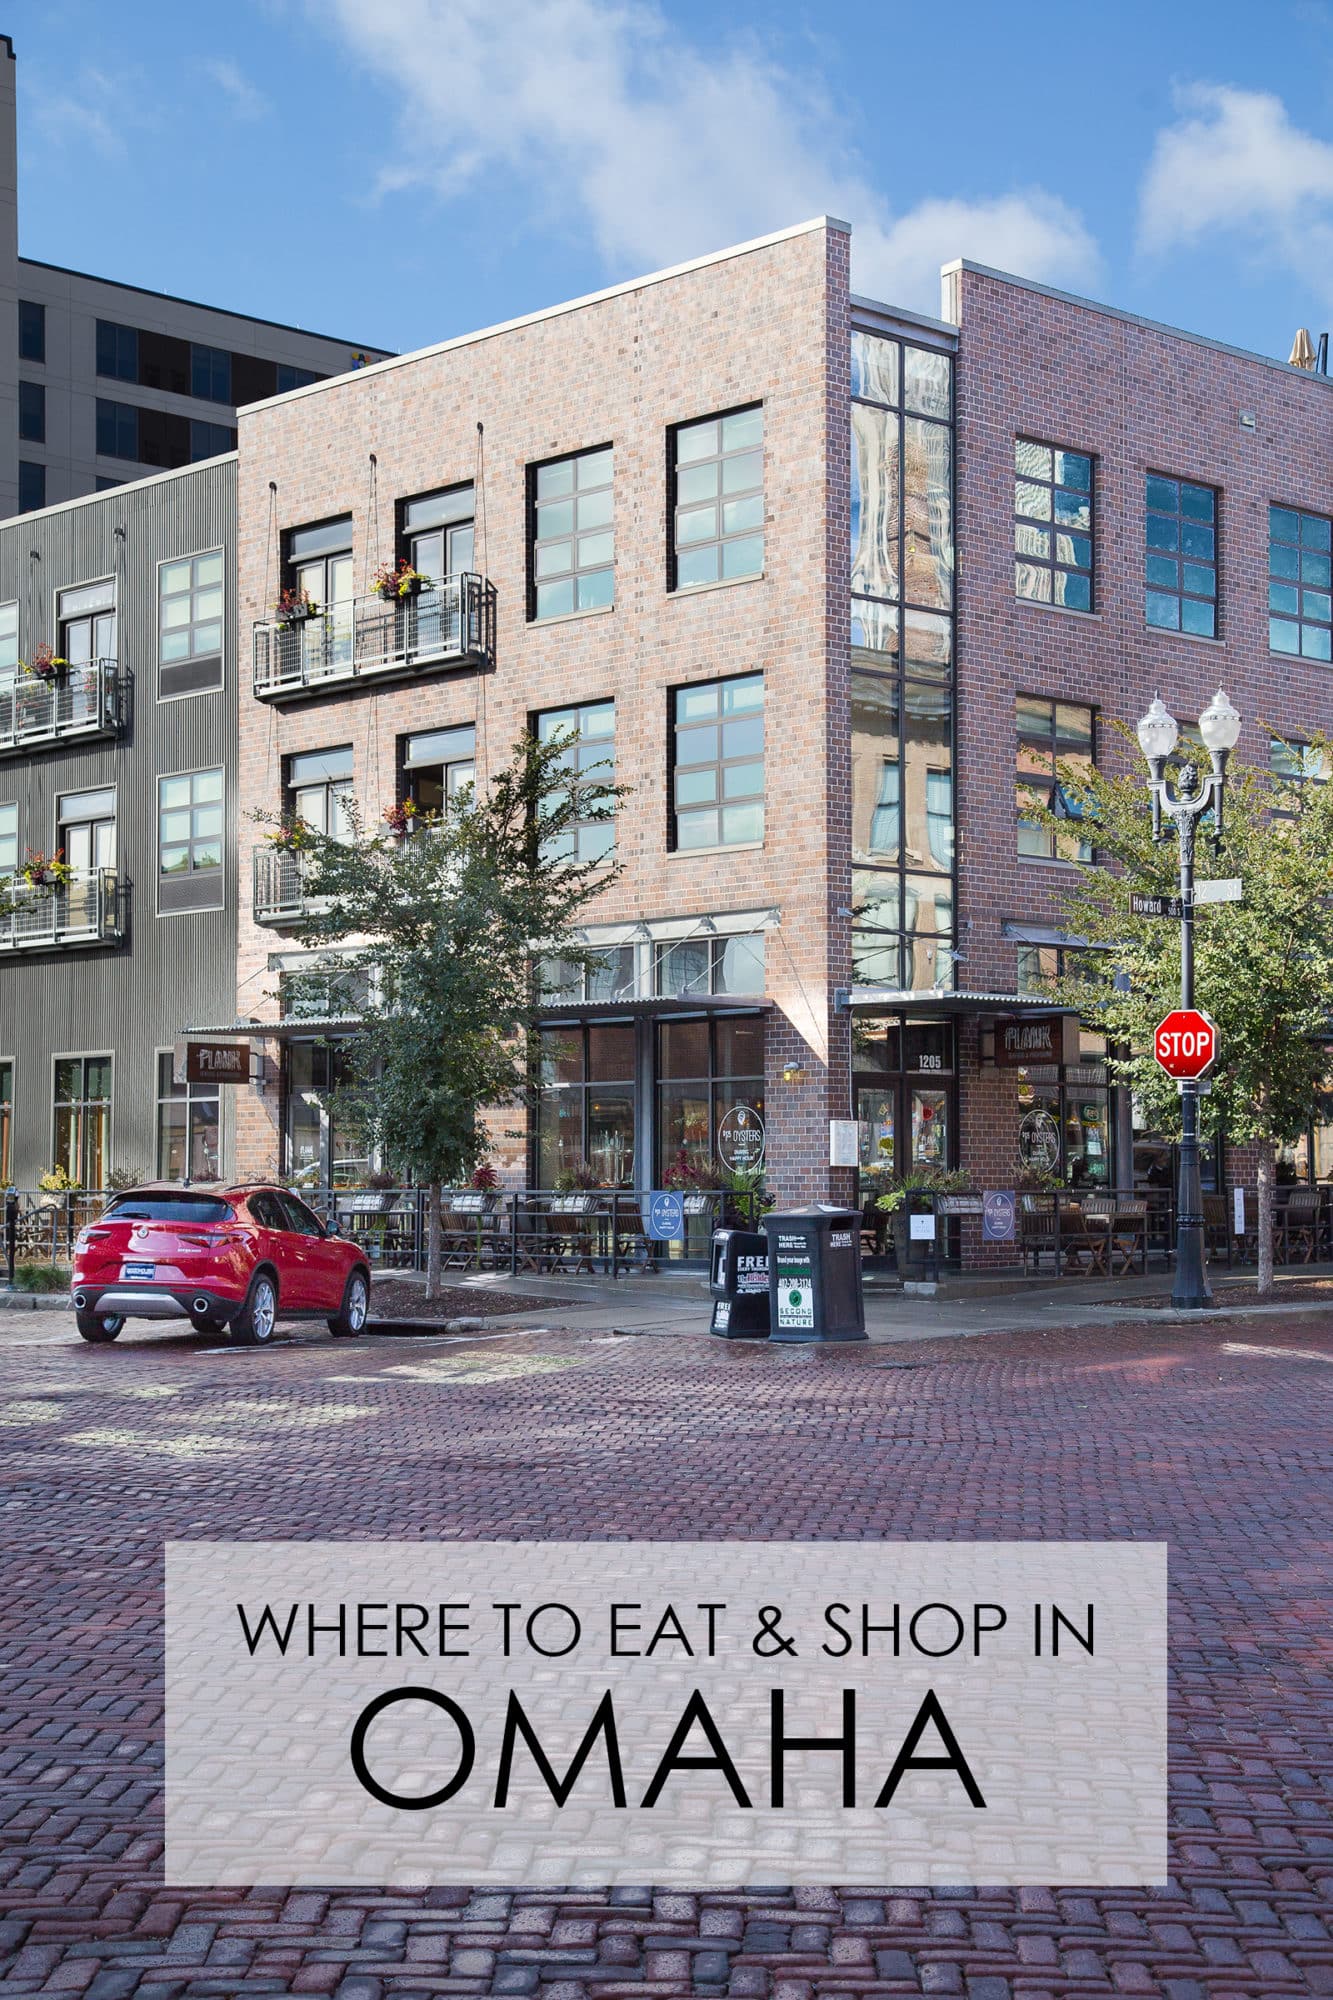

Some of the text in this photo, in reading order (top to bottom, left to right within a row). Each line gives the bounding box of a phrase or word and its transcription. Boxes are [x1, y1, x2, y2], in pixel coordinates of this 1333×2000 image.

[1133, 896, 1162, 914] Howard
[1158, 1032, 1210, 1057] STOP
[919, 1055, 941, 1069] 1205
[733, 1130, 761, 1142] OYSTERS
[832, 1232, 851, 1242] TRASH
